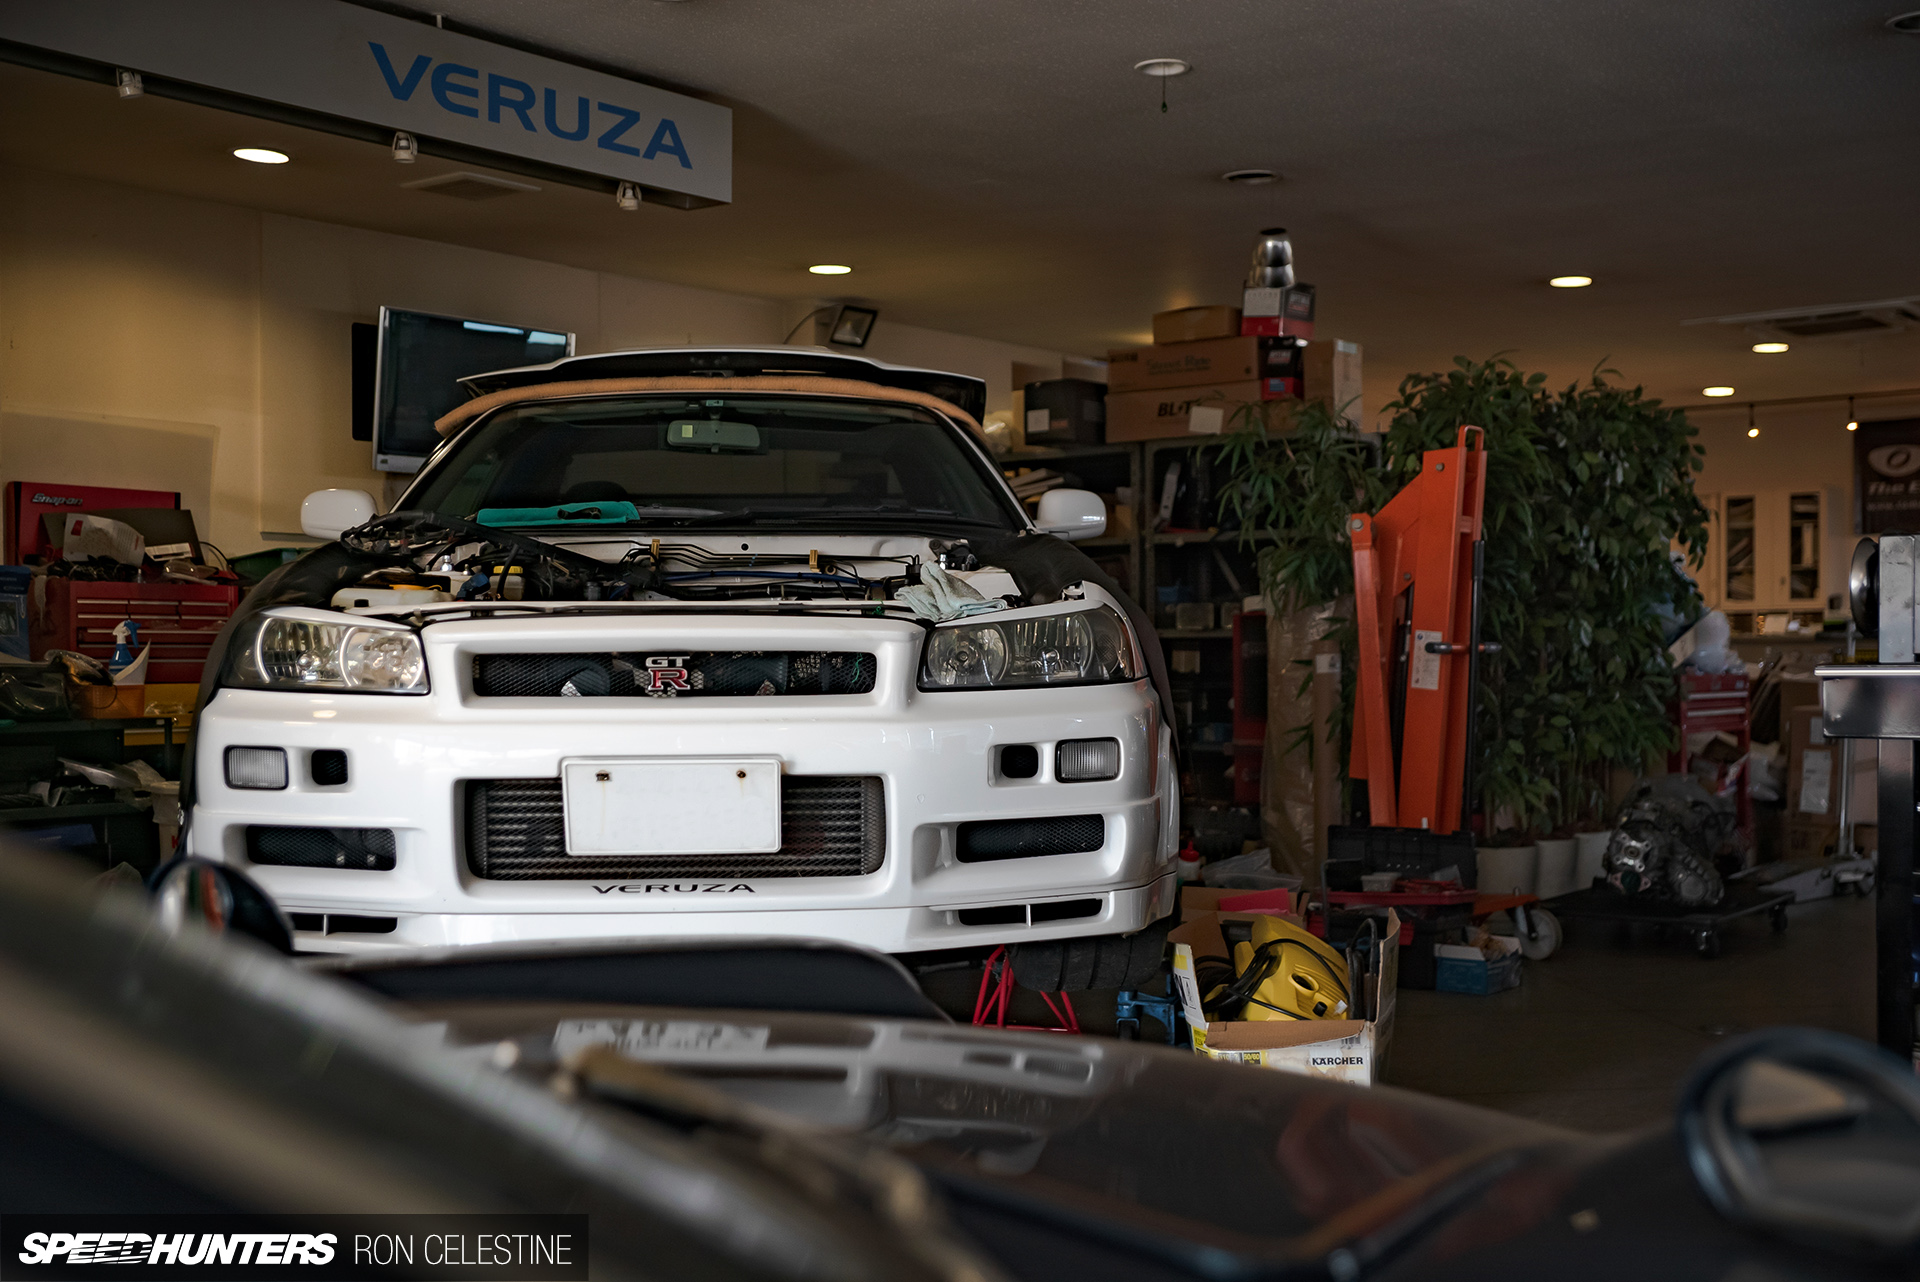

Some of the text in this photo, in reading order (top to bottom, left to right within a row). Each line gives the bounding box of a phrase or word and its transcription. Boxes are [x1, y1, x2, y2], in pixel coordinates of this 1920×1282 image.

[367, 41, 694, 170] VERUZA
[31, 492, 84, 506] Snap-on
[645, 655, 691, 668] GT
[647, 667, 691, 690] R
[592, 883, 756, 894] VERUZA
